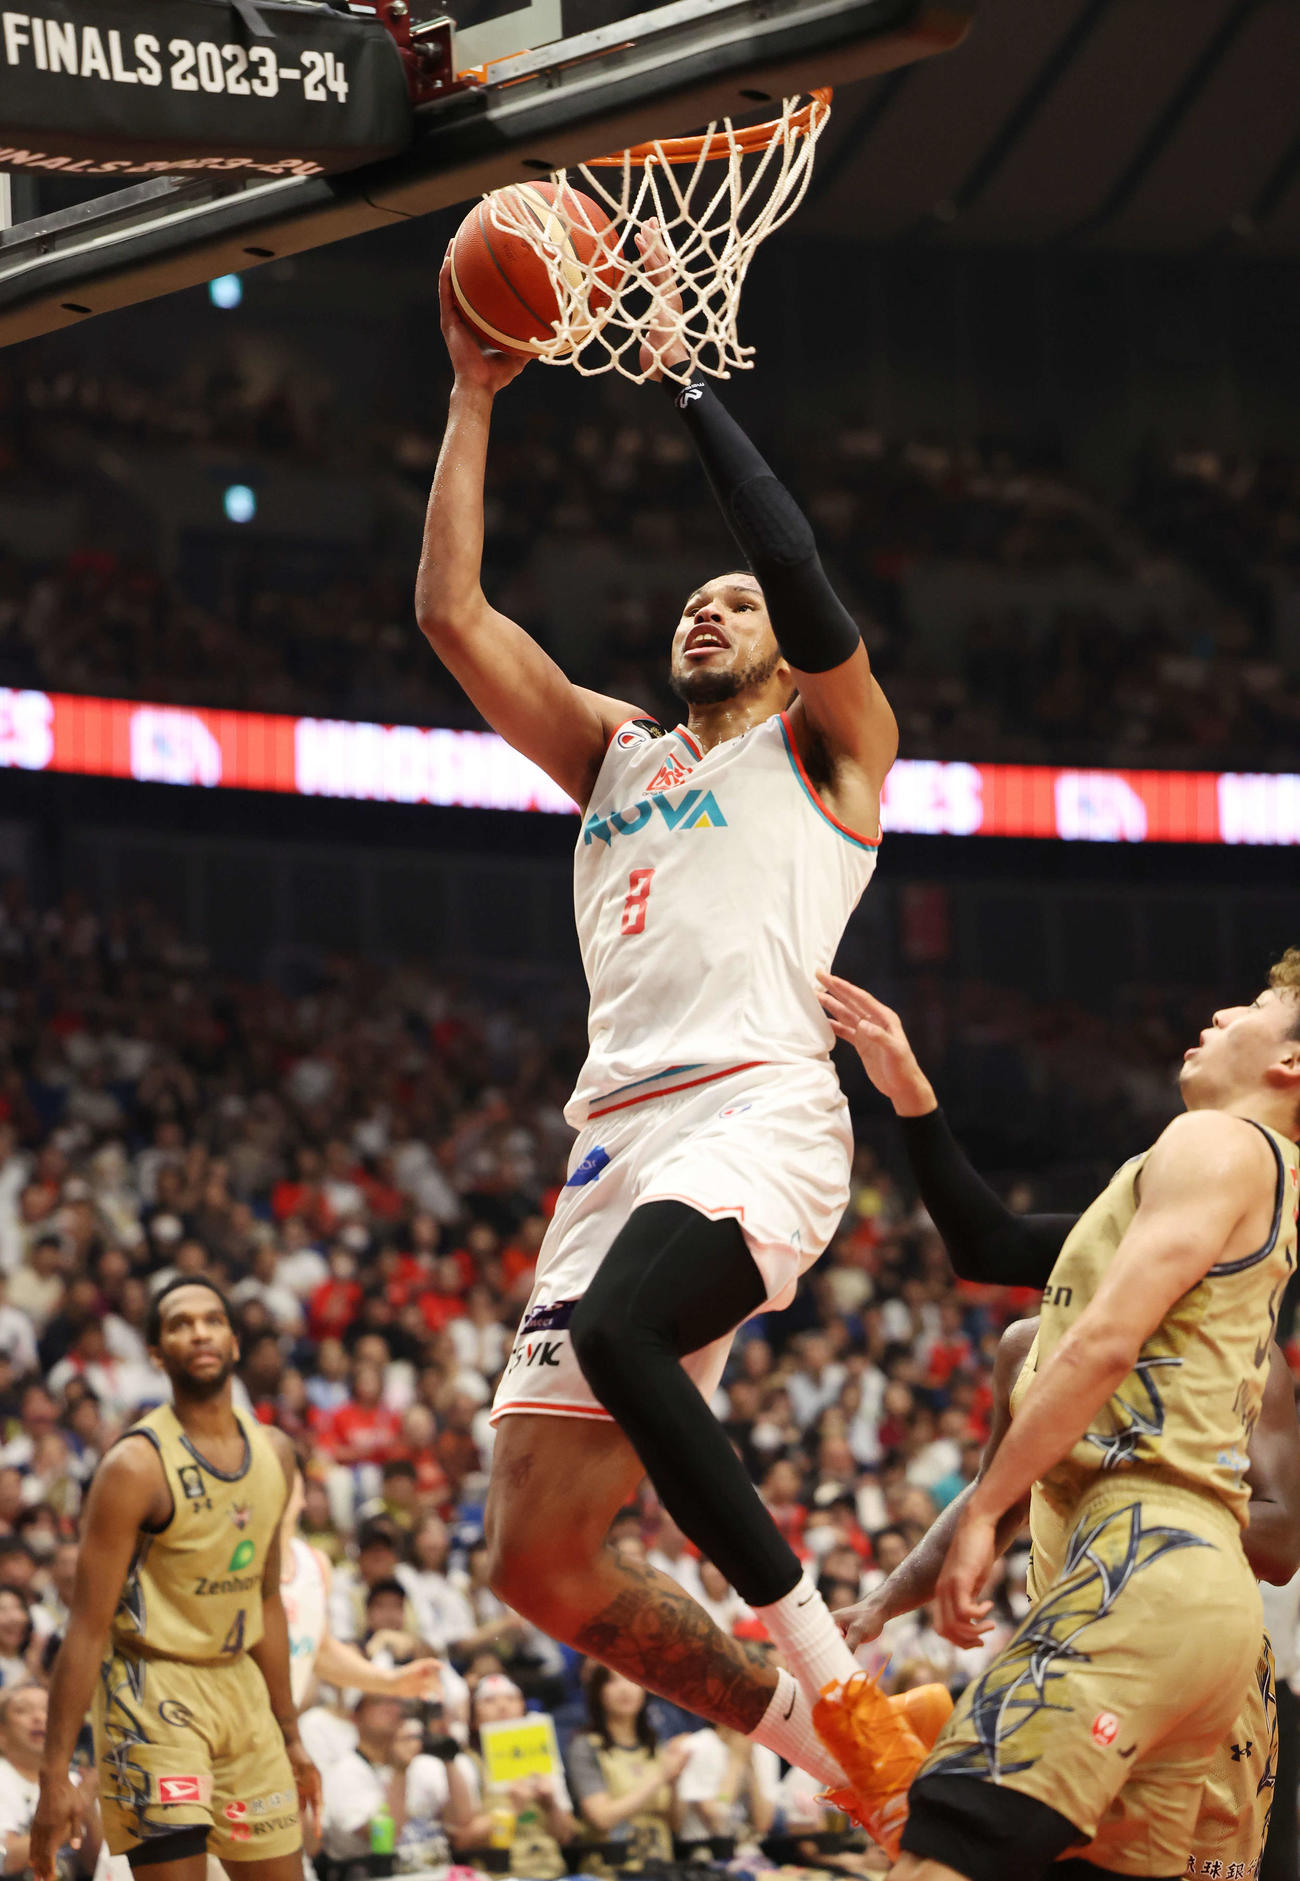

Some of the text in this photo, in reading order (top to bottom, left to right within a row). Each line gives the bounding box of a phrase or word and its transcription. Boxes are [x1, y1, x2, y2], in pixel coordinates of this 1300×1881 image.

[2, 12, 349, 103] FINALS 2023-24
[584, 789, 728, 847] NOVA
[621, 868, 655, 935] 8
[221, 1609, 246, 1655] 4
